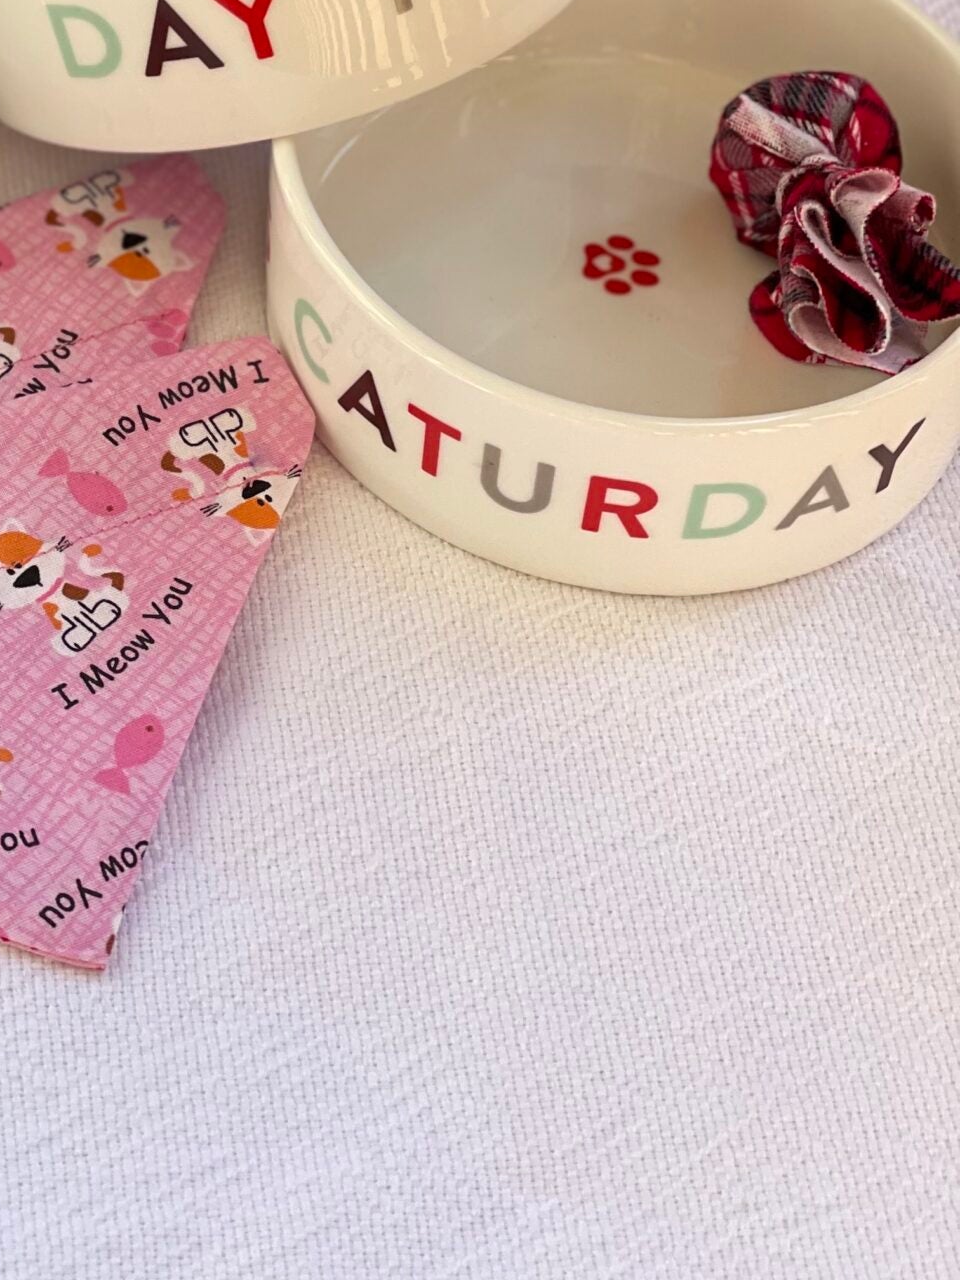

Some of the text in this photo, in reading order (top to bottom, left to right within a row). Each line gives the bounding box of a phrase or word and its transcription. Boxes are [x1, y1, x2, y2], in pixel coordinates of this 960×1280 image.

[33, 328, 79, 374] You
[102, 359, 270, 447] I Meow You
[293, 297, 926, 540] CATURDAY
[51, 577, 193, 710] I Meow You
[38, 878, 103, 929] You
